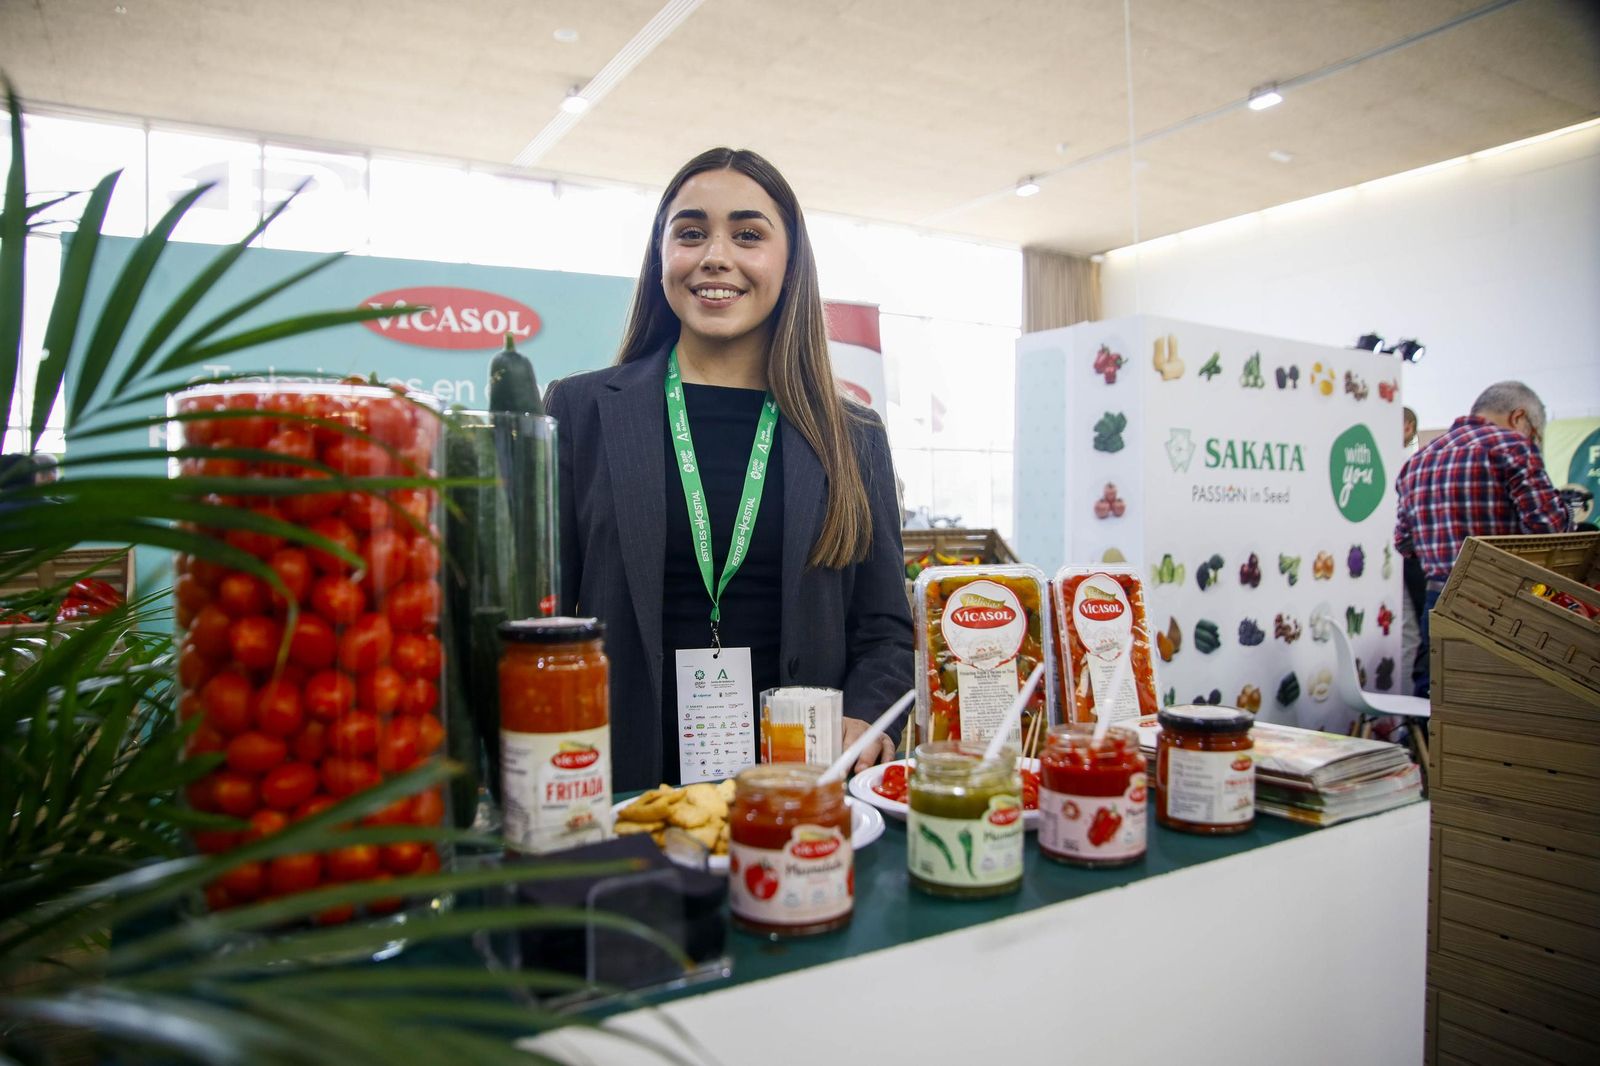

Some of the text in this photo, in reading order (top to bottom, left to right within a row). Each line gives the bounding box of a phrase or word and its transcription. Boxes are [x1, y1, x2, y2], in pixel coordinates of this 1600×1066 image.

[1205, 438, 1305, 471] SAKATA
[1344, 442, 1371, 465] with
[1250, 487, 1261, 503] in
[1263, 486, 1290, 504] Seed
[1339, 466, 1373, 508] you
[699, 530, 707, 540] ES
[736, 535, 746, 547] ES
[699, 541, 709, 562] ESTO
[732, 544, 743, 567] ESTO
[546, 777, 603, 801] FRITADA
